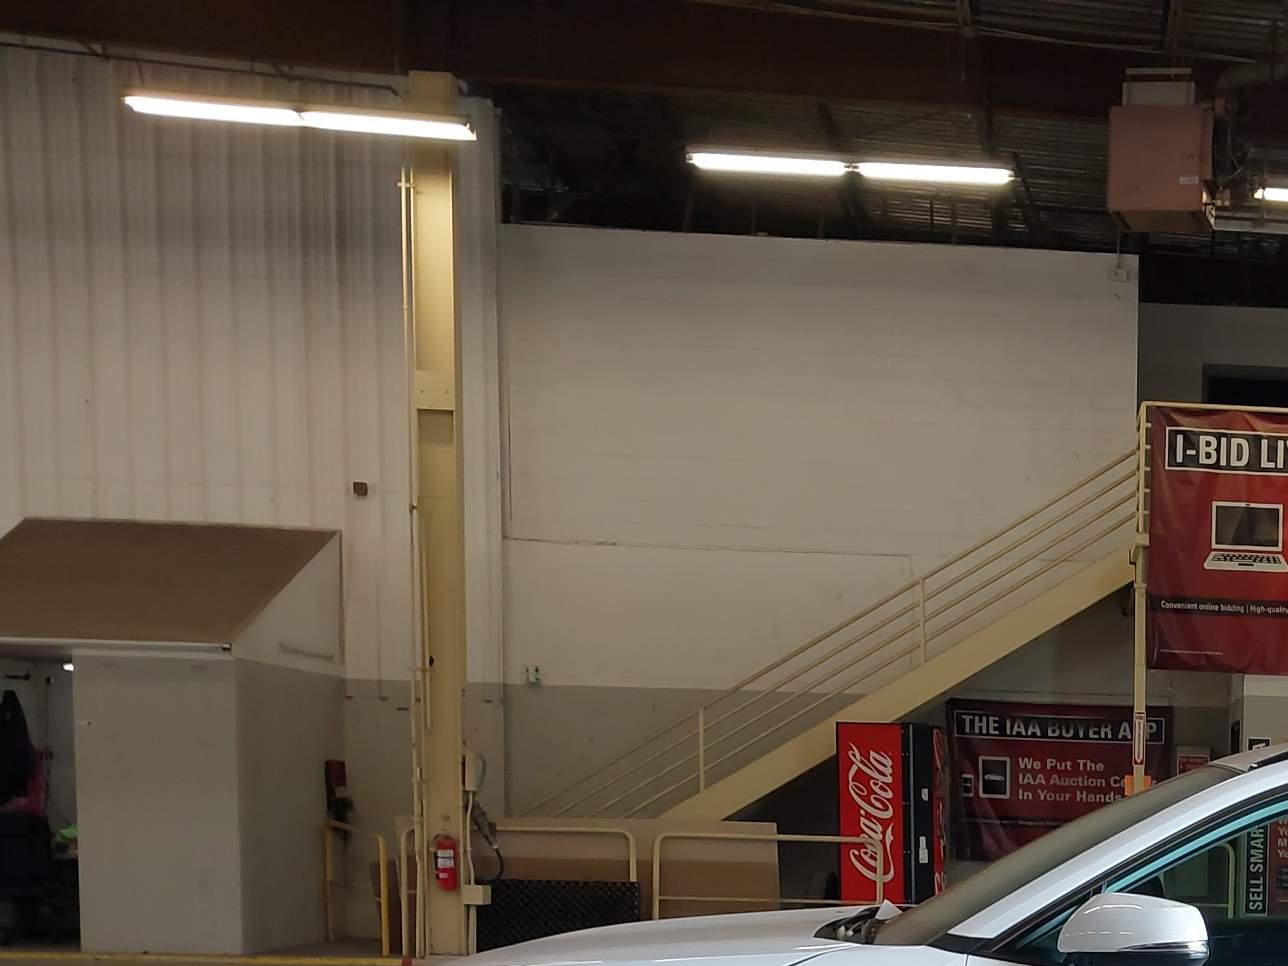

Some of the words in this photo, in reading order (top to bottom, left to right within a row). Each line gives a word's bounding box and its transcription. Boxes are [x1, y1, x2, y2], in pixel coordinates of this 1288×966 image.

[1175, 434, 1250, 466] I-BID
[1161, 600, 1198, 610] Convenient
[1199, 602, 1219, 611] online
[1220, 603, 1245, 614] bidding
[1250, 604, 1288, 615] High-quality
[961, 714, 1000, 735] THE
[1006, 718, 1041, 737] IAA
[1047, 720, 1113, 740] BUYER
[1118, 721, 1158, 740] AP
[1018, 757, 1041, 770] We
[1046, 758, 1073, 771] Put
[1077, 759, 1105, 772] The
[1018, 773, 1046, 785] IAA
[1050, 774, 1106, 788] Auction
[1018, 789, 1035, 800] In
[1038, 789, 1072, 801] Your
[1076, 790, 1123, 803] Hands
[1249, 825, 1265, 873] SMAR
[1248, 876, 1264, 911] SELL
